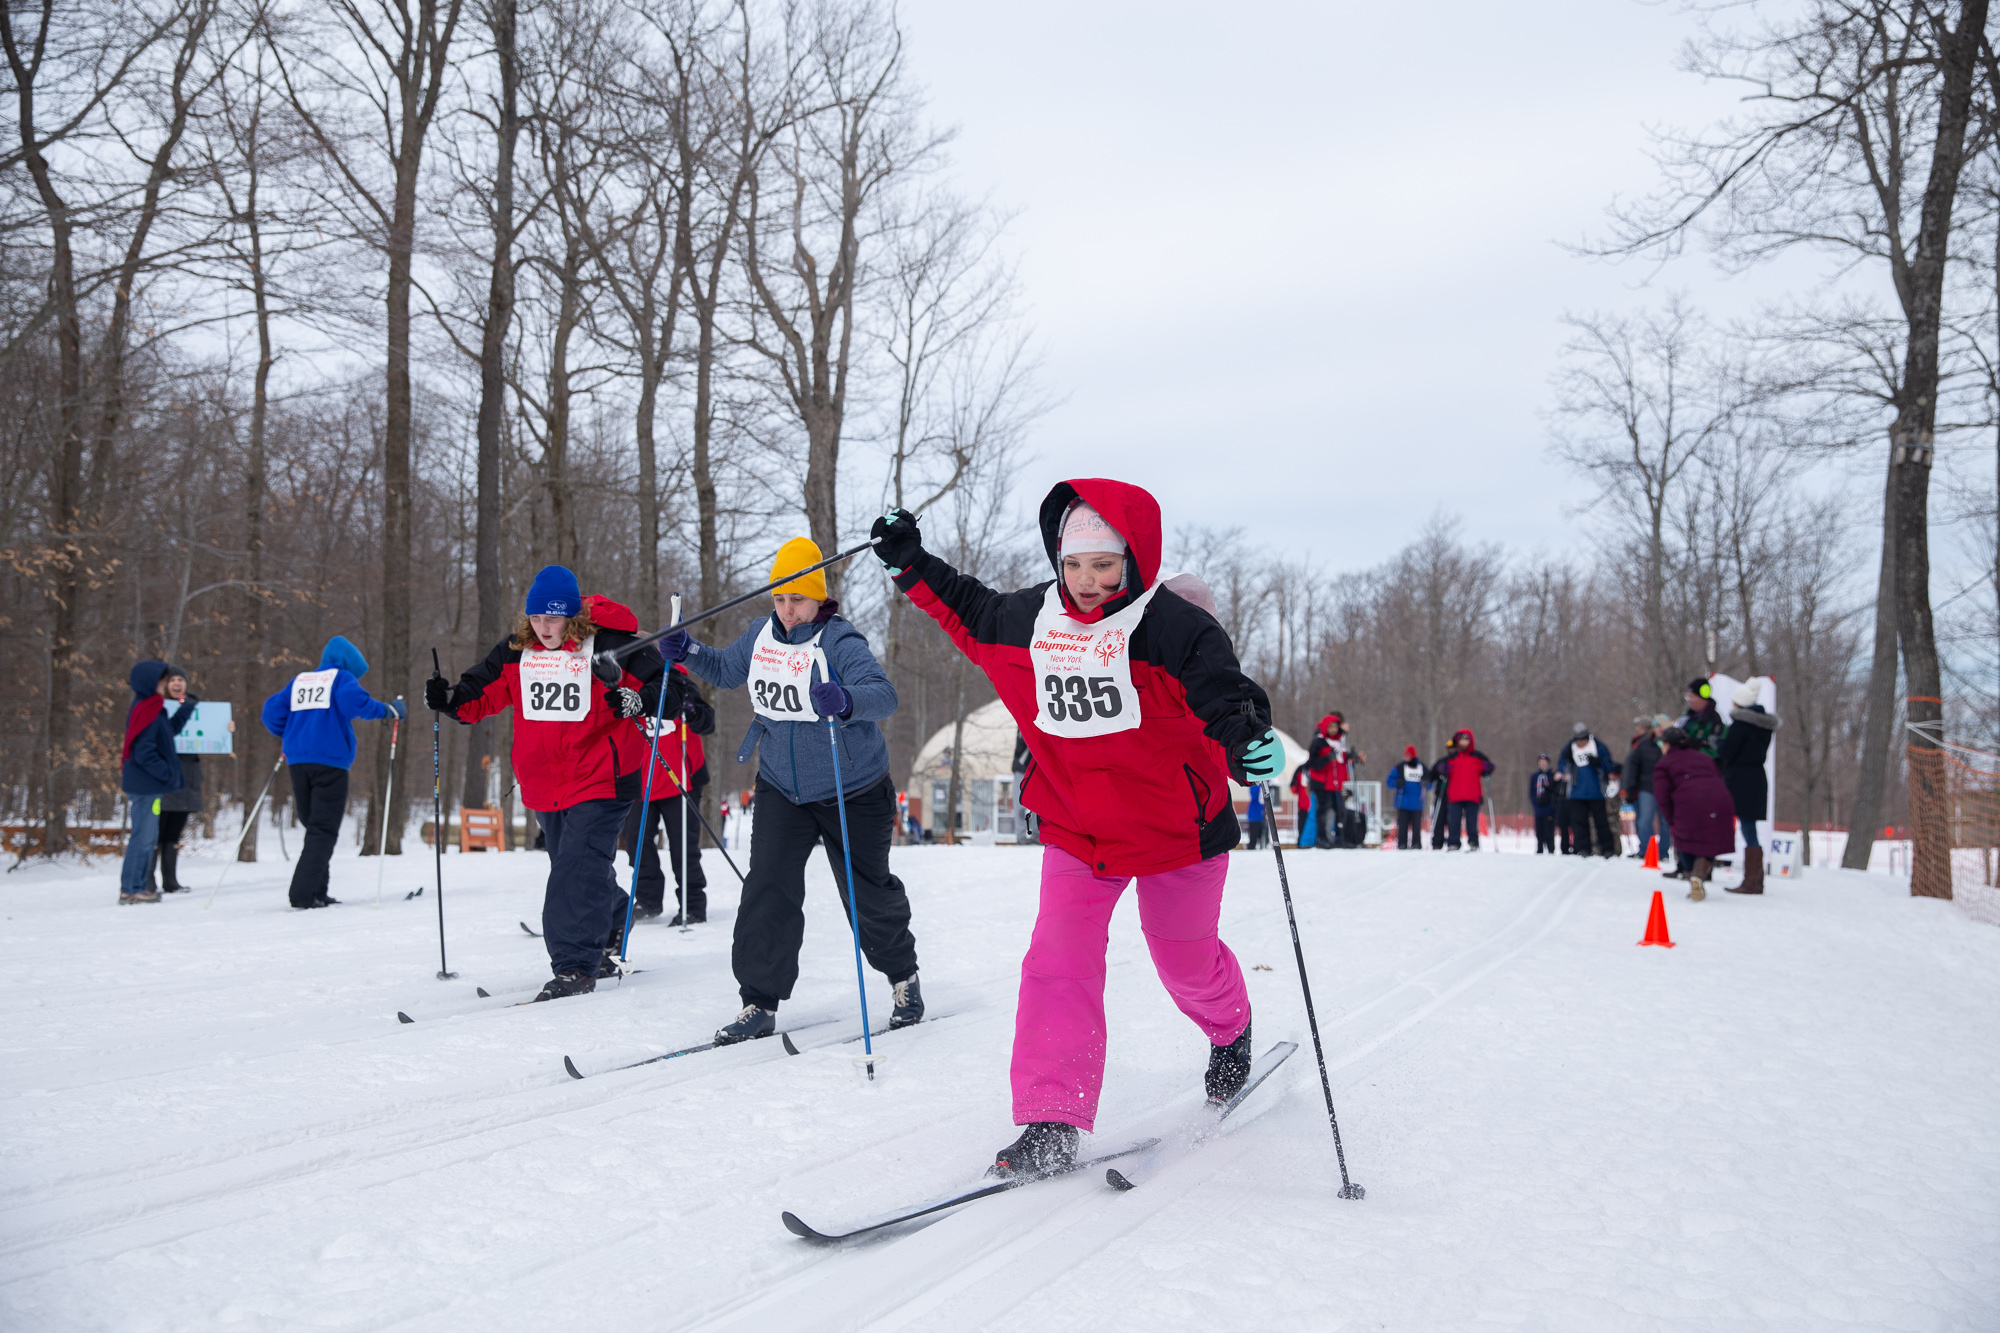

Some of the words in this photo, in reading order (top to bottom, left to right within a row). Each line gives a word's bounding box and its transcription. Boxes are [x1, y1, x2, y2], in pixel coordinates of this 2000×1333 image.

[1046, 629, 1094, 643] Special
[760, 646, 787, 657] Special
[1033, 640, 1088, 653] Olympics
[531, 654, 562, 662] Special
[753, 653, 783, 665] Olympics
[1049, 654, 1066, 664] New
[1067, 655, 1083, 664] York
[522, 661, 560, 669] Olympics
[297, 686, 325, 704] 312
[530, 681, 581, 712] 326
[754, 679, 804, 713] 320
[1044, 674, 1123, 723] 335
